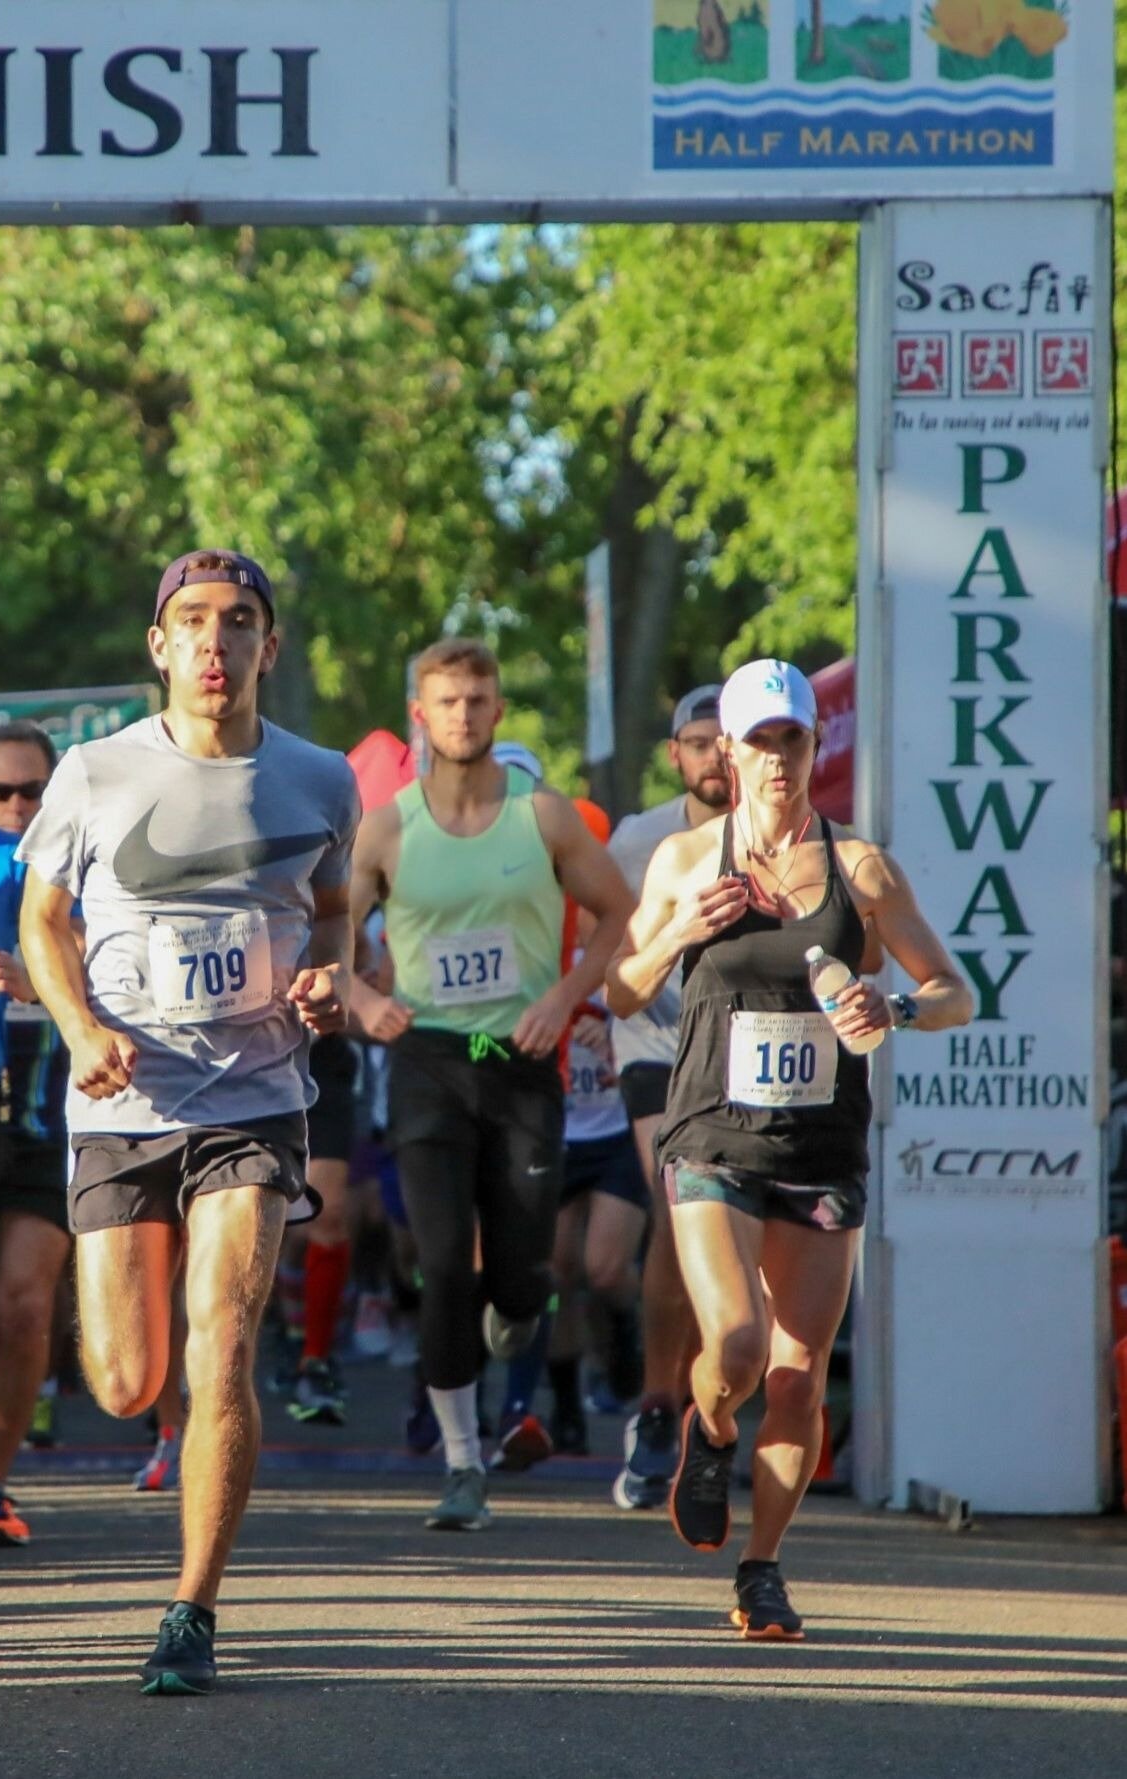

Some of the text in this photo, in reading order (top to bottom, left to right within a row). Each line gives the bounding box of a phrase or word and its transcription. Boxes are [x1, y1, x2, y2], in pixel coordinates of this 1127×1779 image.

[675, 127, 1035, 156] HALF MARATHON
[928, 442, 1055, 1020] PARKWAY
[178, 947, 247, 1000] 709
[439, 947, 503, 988] 1237
[755, 1041, 816, 1084] 160
[948, 1034, 1036, 1067] HALF
[896, 1073, 1088, 1107] MARATHON
